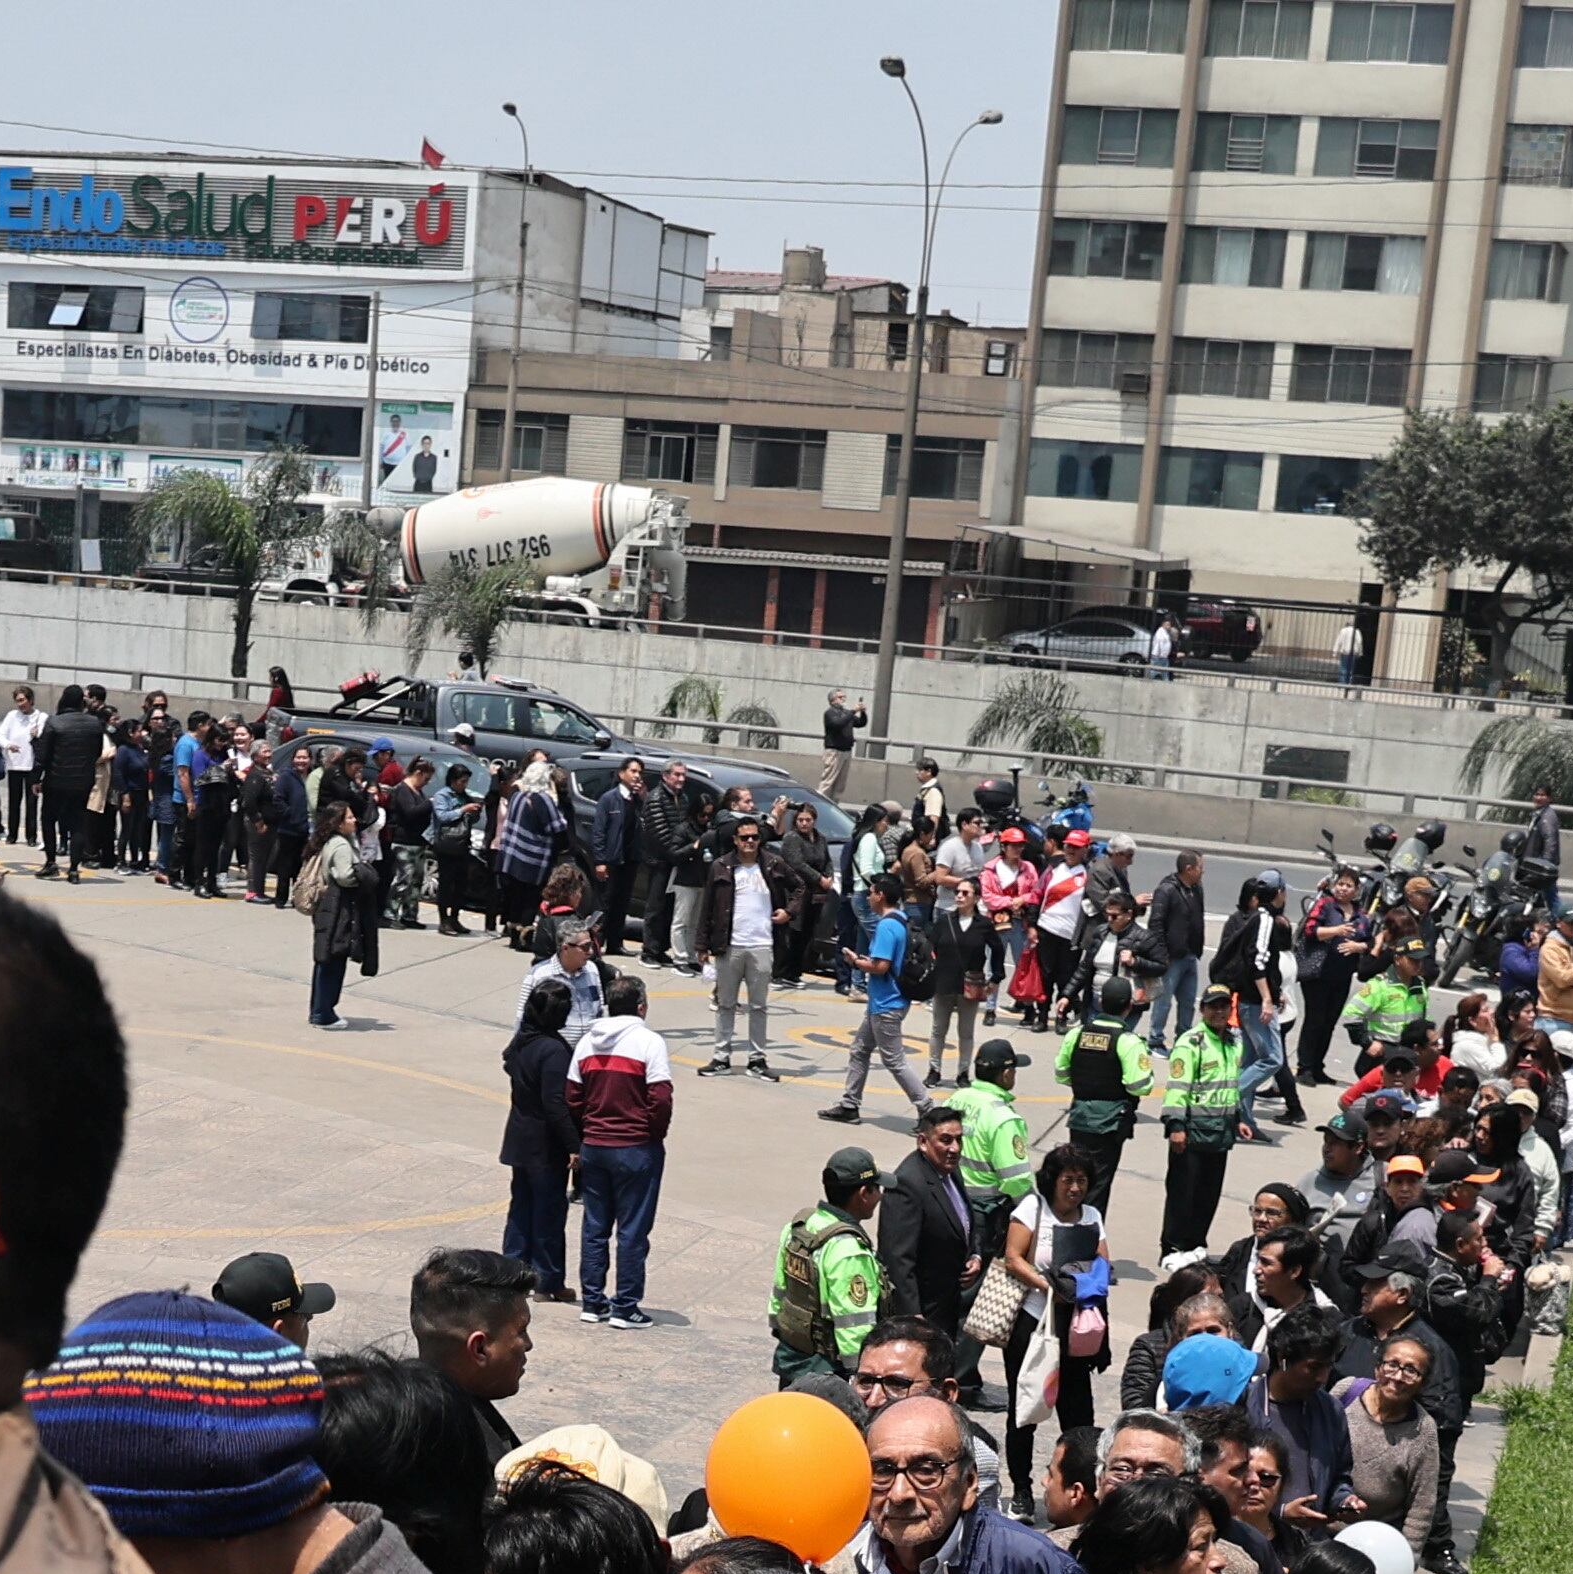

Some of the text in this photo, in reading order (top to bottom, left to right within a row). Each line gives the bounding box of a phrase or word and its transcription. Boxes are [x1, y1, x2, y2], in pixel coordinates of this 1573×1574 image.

[126, 172, 276, 240] Salud
[293, 182, 453, 247] PERÚ
[17, 341, 117, 358] Especialistas
[123, 346, 143, 360] En
[226, 350, 301, 367] Obesidad
[308, 354, 318, 368] &
[325, 355, 348, 370] Pie
